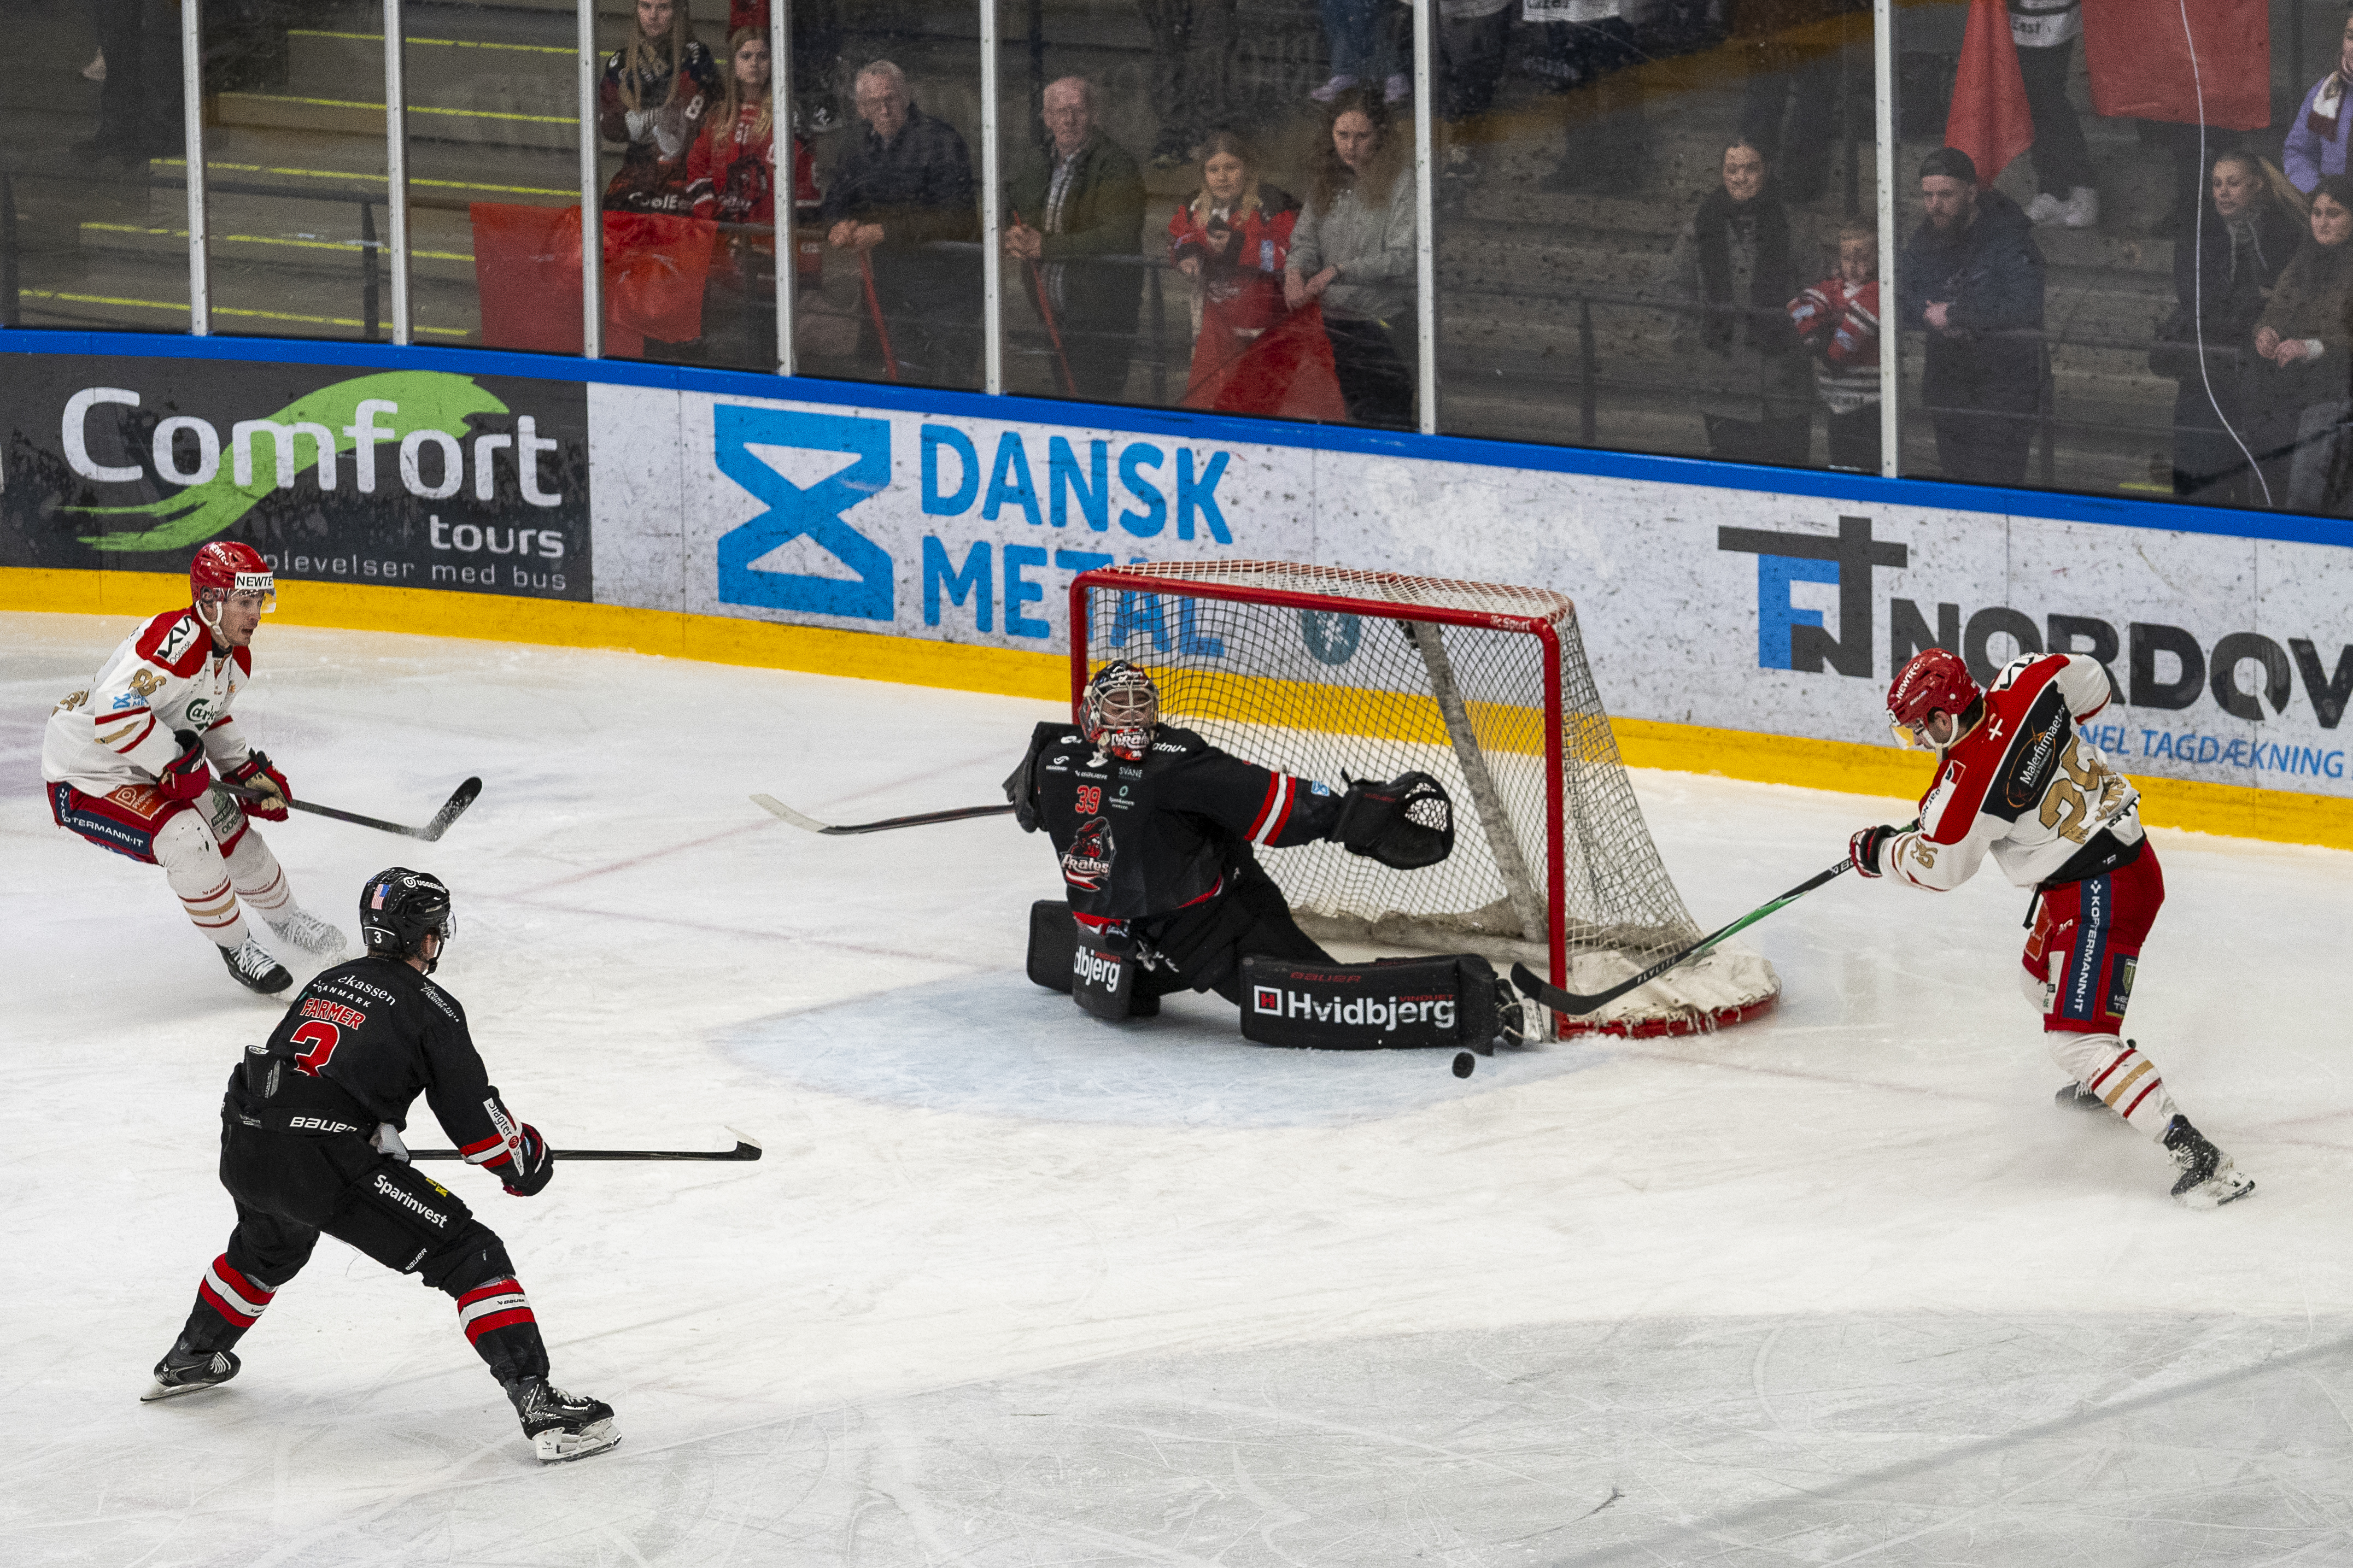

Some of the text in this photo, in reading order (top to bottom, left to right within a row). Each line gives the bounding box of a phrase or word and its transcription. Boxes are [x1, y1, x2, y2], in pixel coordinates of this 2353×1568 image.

[62, 386, 563, 507] Comfort
[921, 424, 1232, 544] DANSK
[430, 514, 564, 557] tours
[431, 561, 496, 586] med
[514, 565, 566, 591] bus
[922, 535, 1225, 657] METAL
[2019, 713, 2063, 784] Malerfirmaet
[2141, 729, 2345, 779] TAGDÆKNING
[1075, 785, 1102, 815] 39
[373, 931, 382, 944] 3
[300, 997, 366, 1030] FARMER
[1287, 990, 1455, 1031] Hvidbjerg
[373, 1174, 448, 1228] Sparinvest
